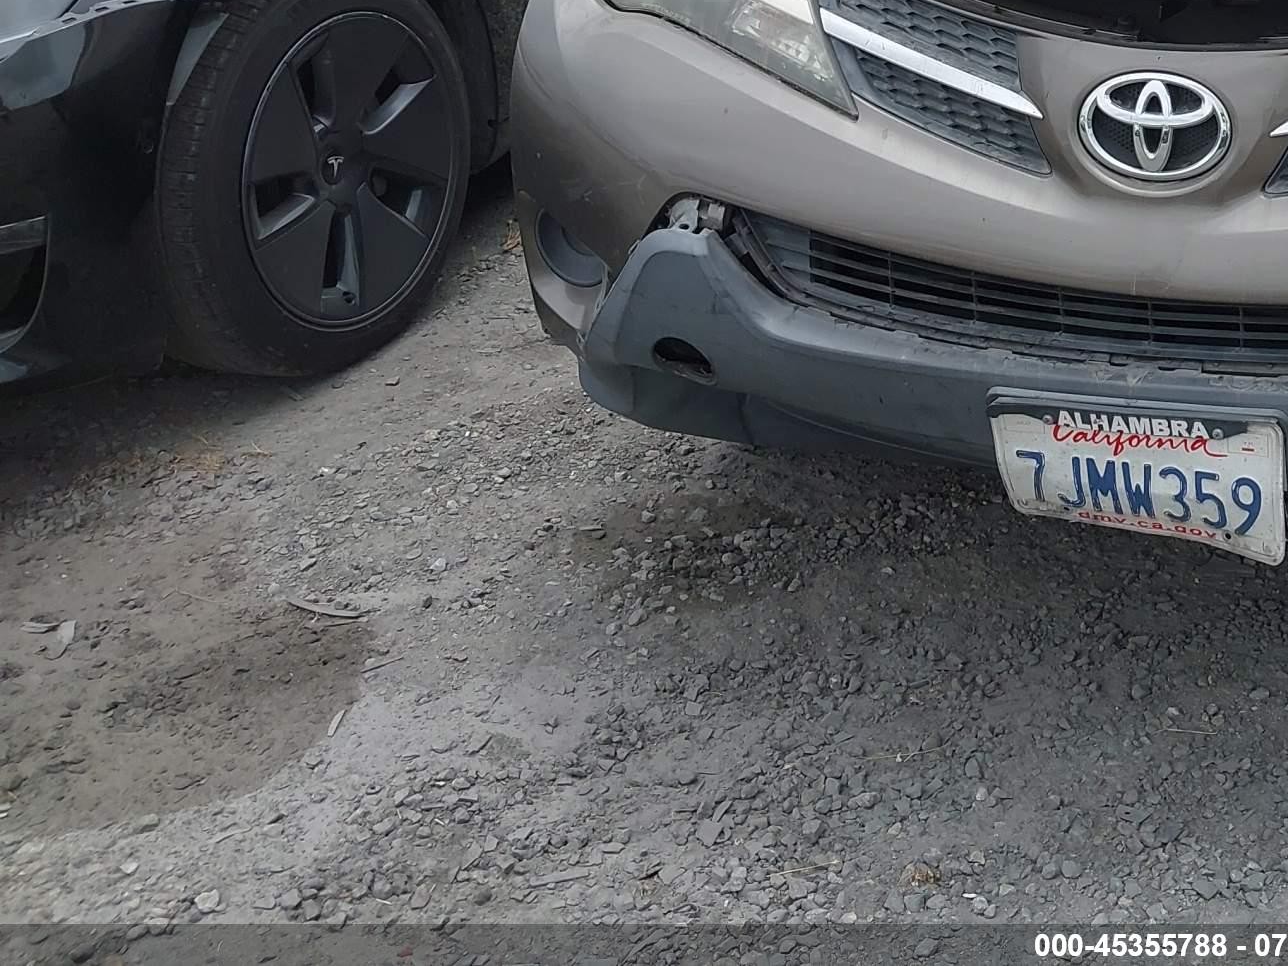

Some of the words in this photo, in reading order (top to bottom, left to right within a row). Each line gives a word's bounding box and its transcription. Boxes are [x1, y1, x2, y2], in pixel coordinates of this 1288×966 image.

[1053, 423, 1228, 458] California
[1057, 410, 1210, 439] ALHAMBRA
[1015, 449, 1263, 537] 7JMW359
